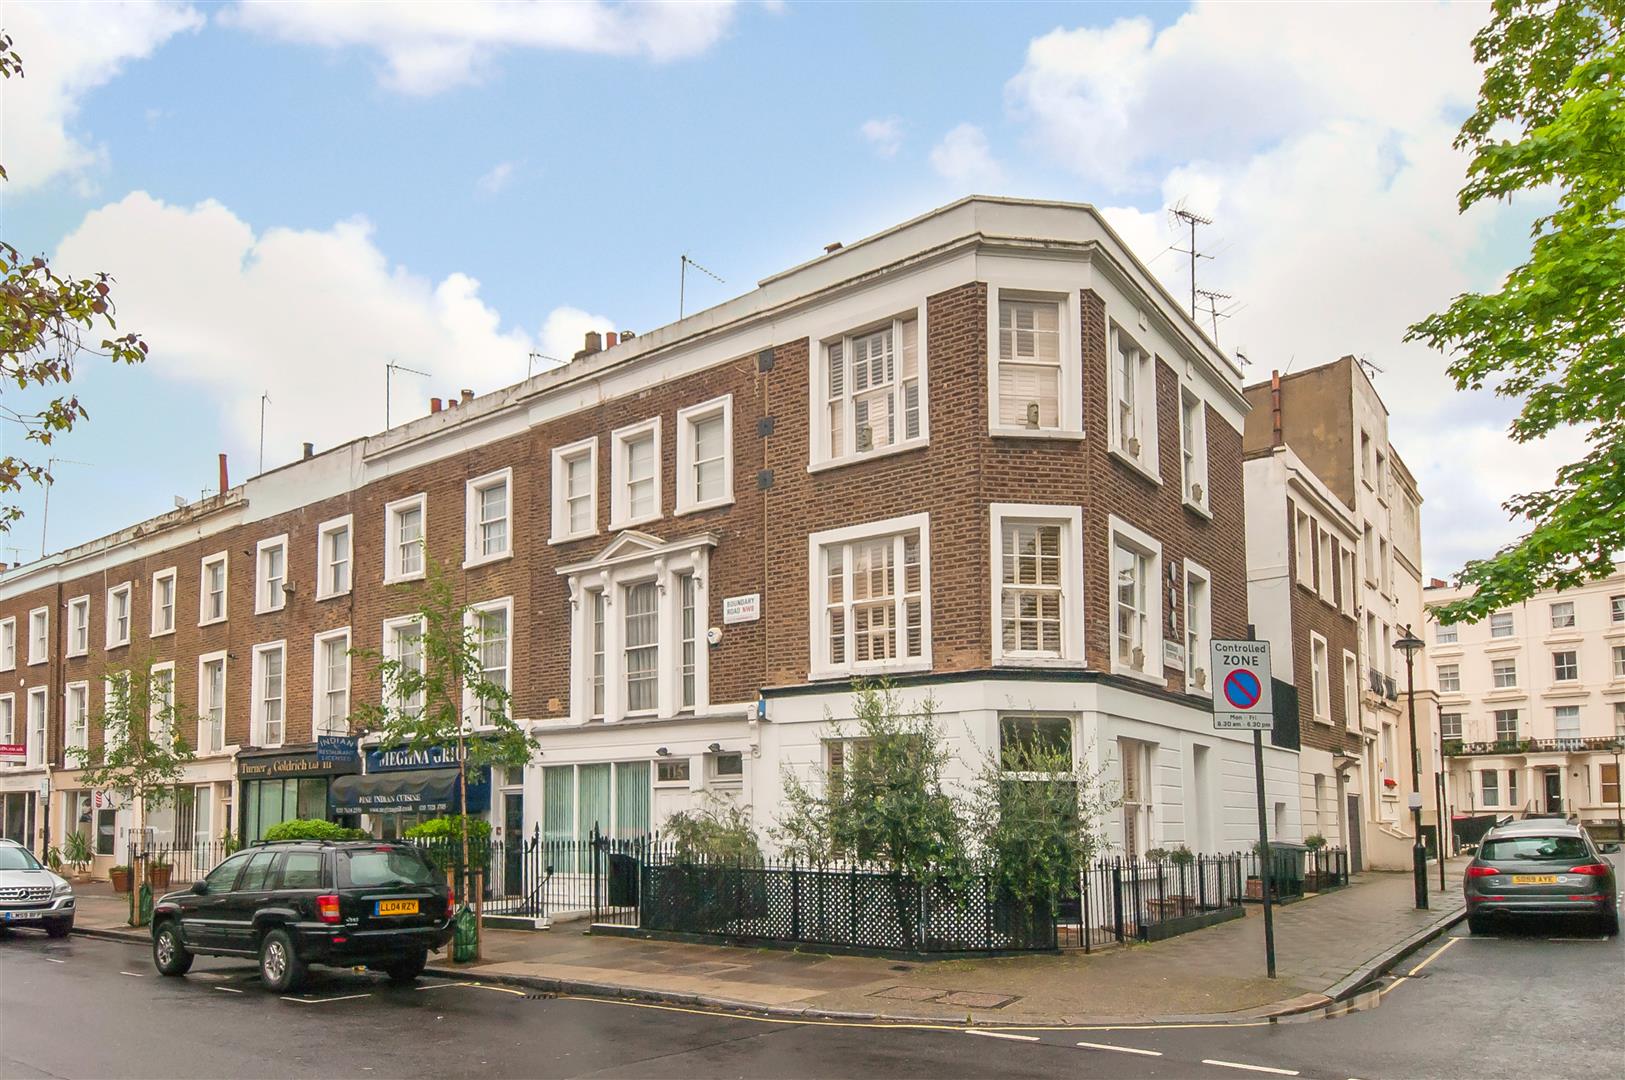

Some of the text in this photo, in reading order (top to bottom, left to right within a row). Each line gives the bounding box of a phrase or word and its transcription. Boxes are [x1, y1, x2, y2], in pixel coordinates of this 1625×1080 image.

[727, 598, 754, 608] BOUNDARY
[1215, 643, 1266, 653] Controlled
[1223, 655, 1259, 666] ZONE
[319, 737, 354, 748] INDIAN
[240, 763, 267, 774] Turner
[273, 759, 307, 772] Goldrich
[359, 793, 421, 804] FINE INDIAN CUISINE
[380, 902, 416, 911] LL04 RZY
